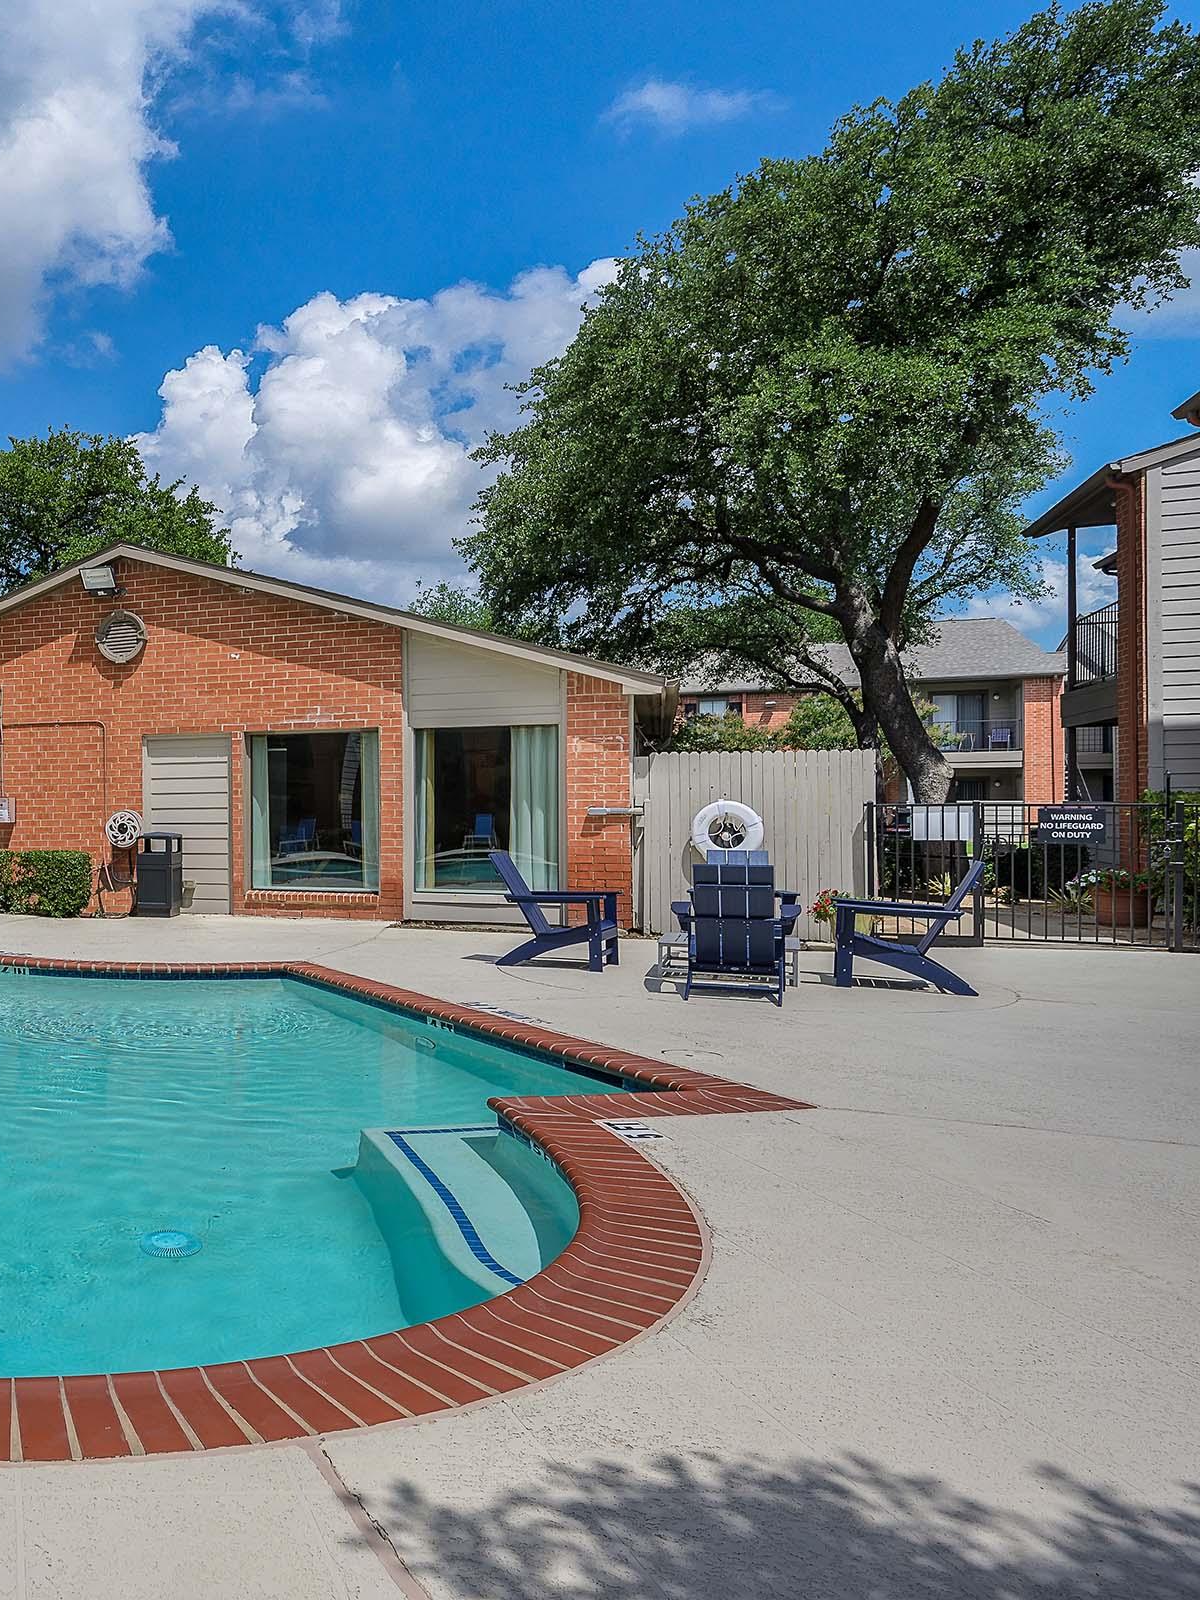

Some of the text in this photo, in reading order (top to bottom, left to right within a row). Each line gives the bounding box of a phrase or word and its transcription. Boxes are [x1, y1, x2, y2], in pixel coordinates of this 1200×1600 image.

[1050, 813, 1093, 821] WARNING
[1055, 822, 1104, 830] LIFEGUARD
[1067, 831, 1092, 839] DUTY
[602, 1121, 650, 1131] FT
